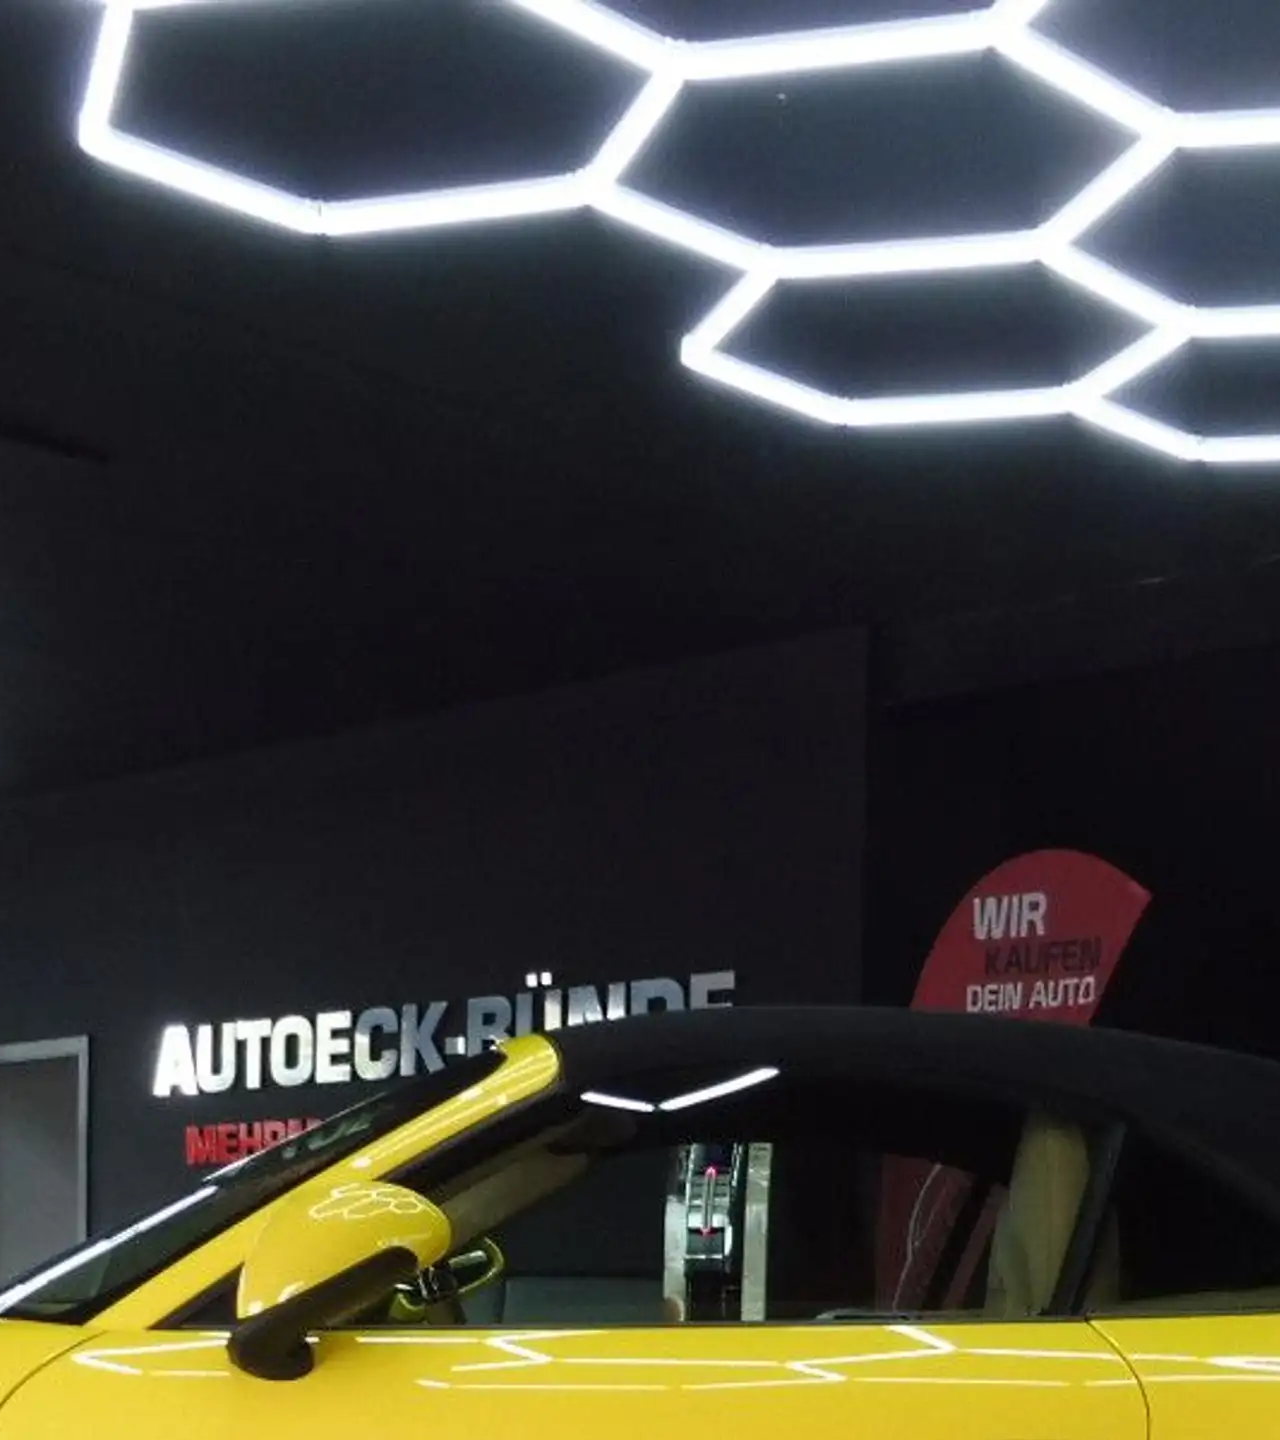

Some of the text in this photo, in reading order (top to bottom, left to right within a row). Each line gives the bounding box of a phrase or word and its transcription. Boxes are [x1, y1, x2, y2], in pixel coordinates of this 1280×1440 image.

[973, 892, 1047, 940] WIR
[985, 937, 1101, 976] KAUFEN
[966, 976, 1095, 1013] DEIN AUTO
